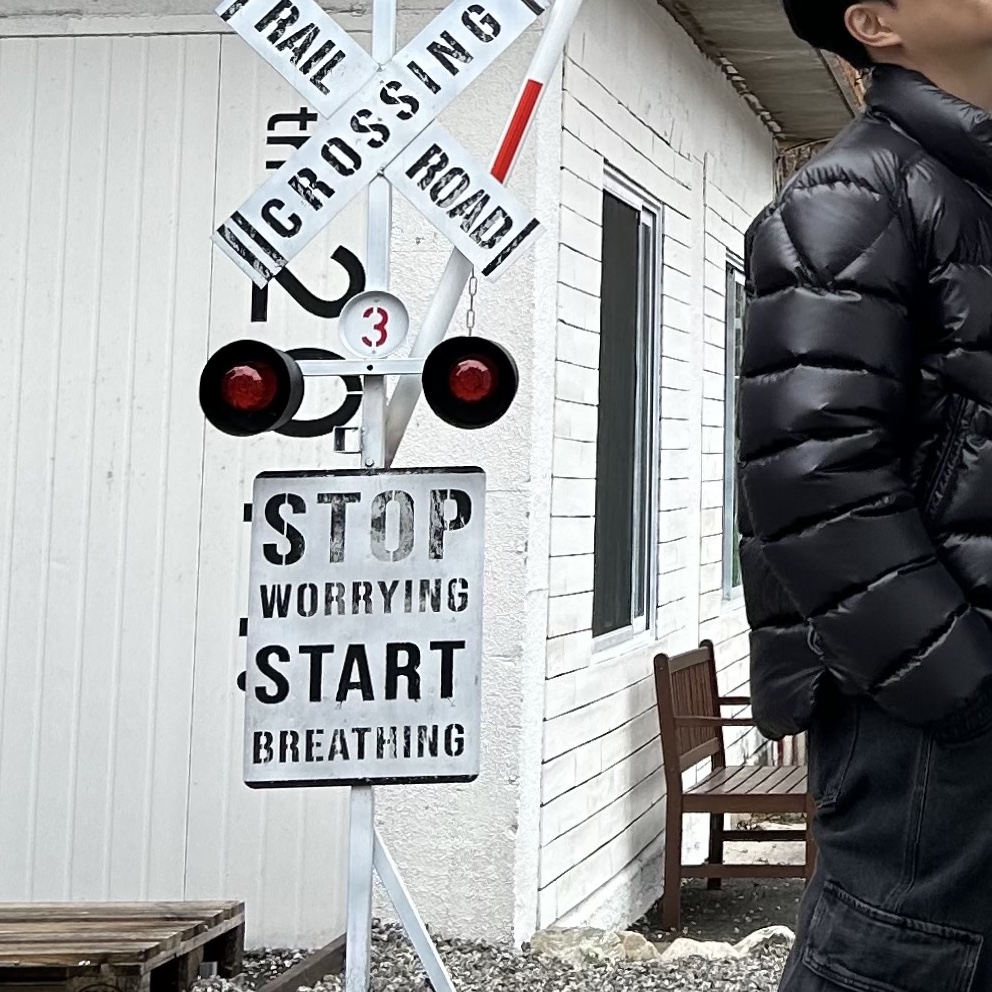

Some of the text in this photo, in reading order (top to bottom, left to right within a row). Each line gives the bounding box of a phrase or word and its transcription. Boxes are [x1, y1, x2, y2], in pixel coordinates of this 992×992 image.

[254, 0, 513, 250] RAIL ROAD
[261, 4, 501, 239] CROSSING
[361, 306, 389, 348] 3
[262, 488, 473, 566] STOP
[259, 577, 469, 619] WORRYING
[254, 640, 466, 704] START
[252, 723, 465, 764] BREATHING
